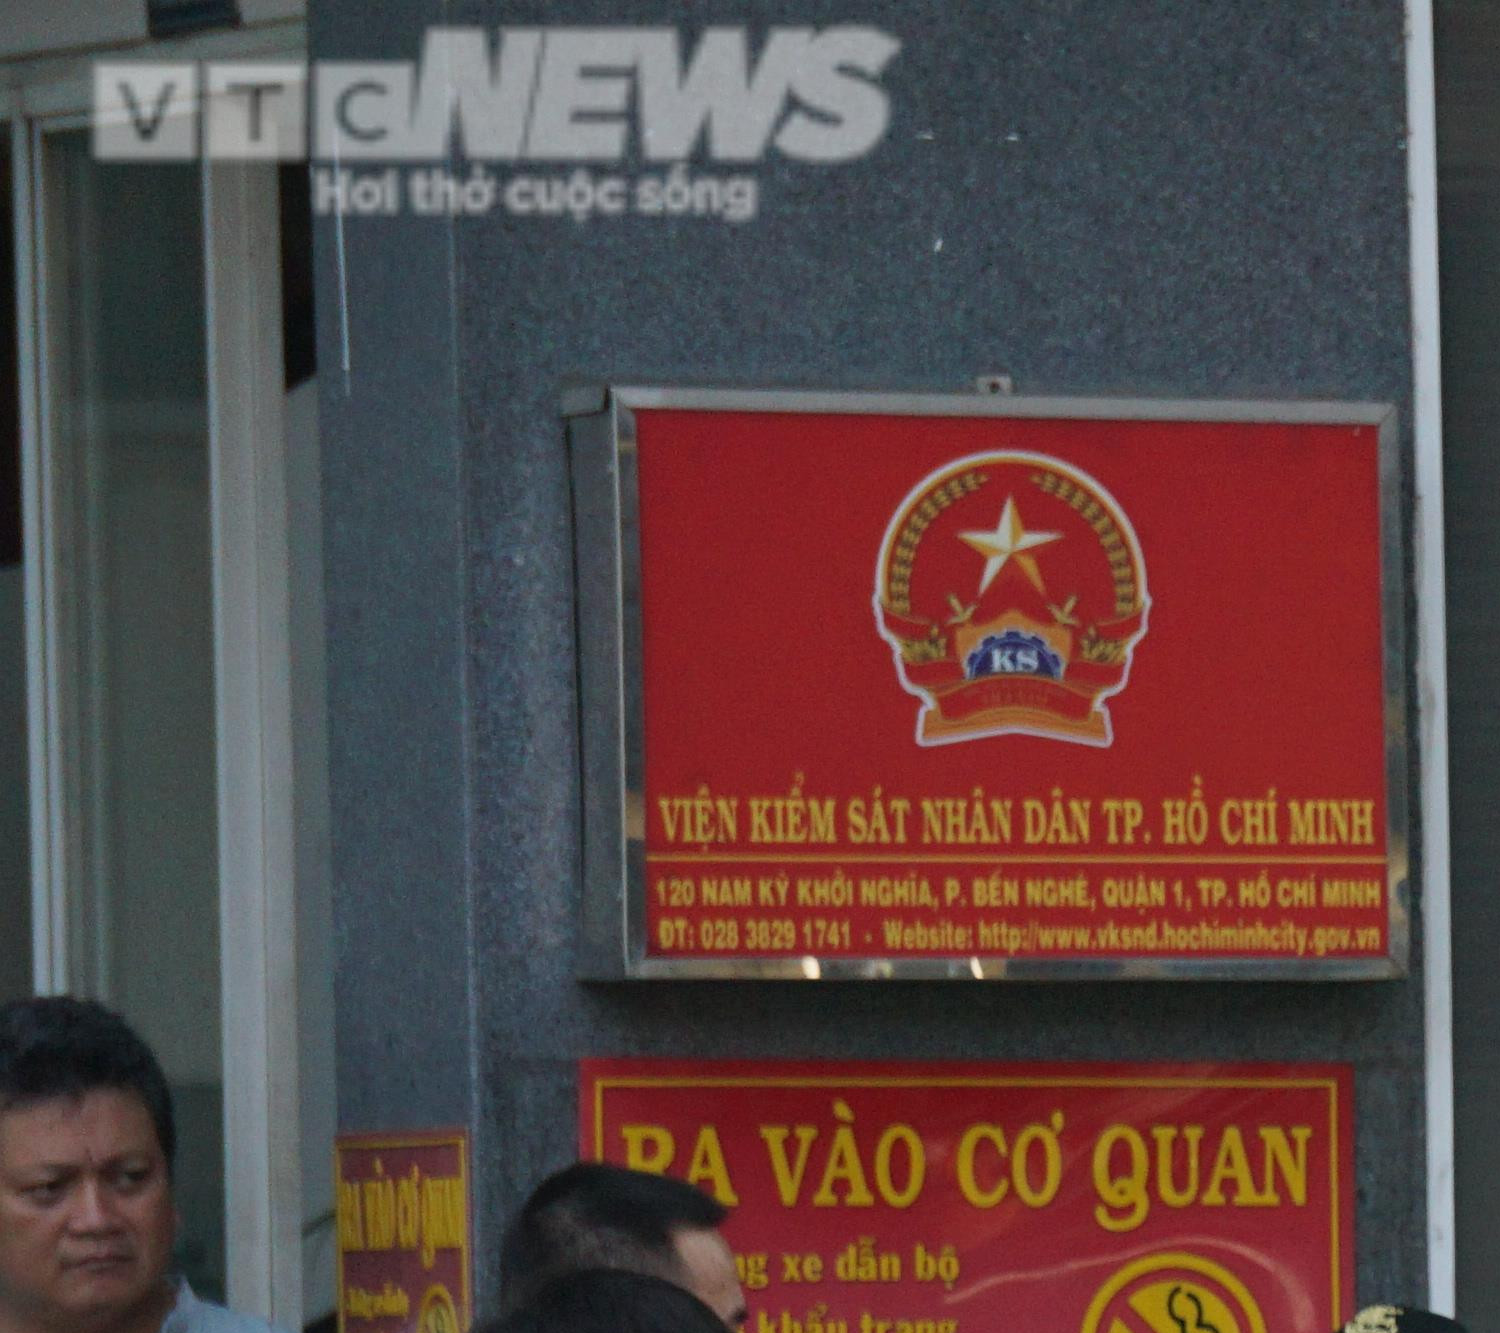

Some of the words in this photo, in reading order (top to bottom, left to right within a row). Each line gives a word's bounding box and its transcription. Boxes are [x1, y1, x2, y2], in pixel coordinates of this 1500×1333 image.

[991, 648, 1038, 673] KS
[658, 785, 738, 852] VIỆN
[750, 770, 837, 844] KIỂM
[848, 784, 910, 844] SÁT
[921, 786, 1012, 844] NHÂN
[1023, 786, 1091, 845] DÂN
[1103, 799, 1151, 845] TP.
[1162, 773, 1209, 845] HỒ
[1219, 786, 1279, 846] CHÍ
[1287, 799, 1375, 846] MINH
[656, 877, 696, 907] 120
[701, 876, 753, 907] NAM
[944, 876, 967, 908] P.
[1102, 871, 1167, 916] QUẬN
[1198, 878, 1234, 908] TP.
[1276, 872, 1317, 908] CHÍ
[1321, 879, 1381, 908] MINH
[700, 917, 740, 950] 028
[745, 917, 797, 950] 3829
[803, 918, 849, 950] 1741
[882, 917, 973, 950] Website:
[759, 1098, 926, 1209] VÀO
[955, 1109, 1065, 1209] CƠ
[1091, 1123, 1314, 1233] QUAN
[781, 1252, 824, 1283] xe
[912, 1241, 960, 1292] bộ
